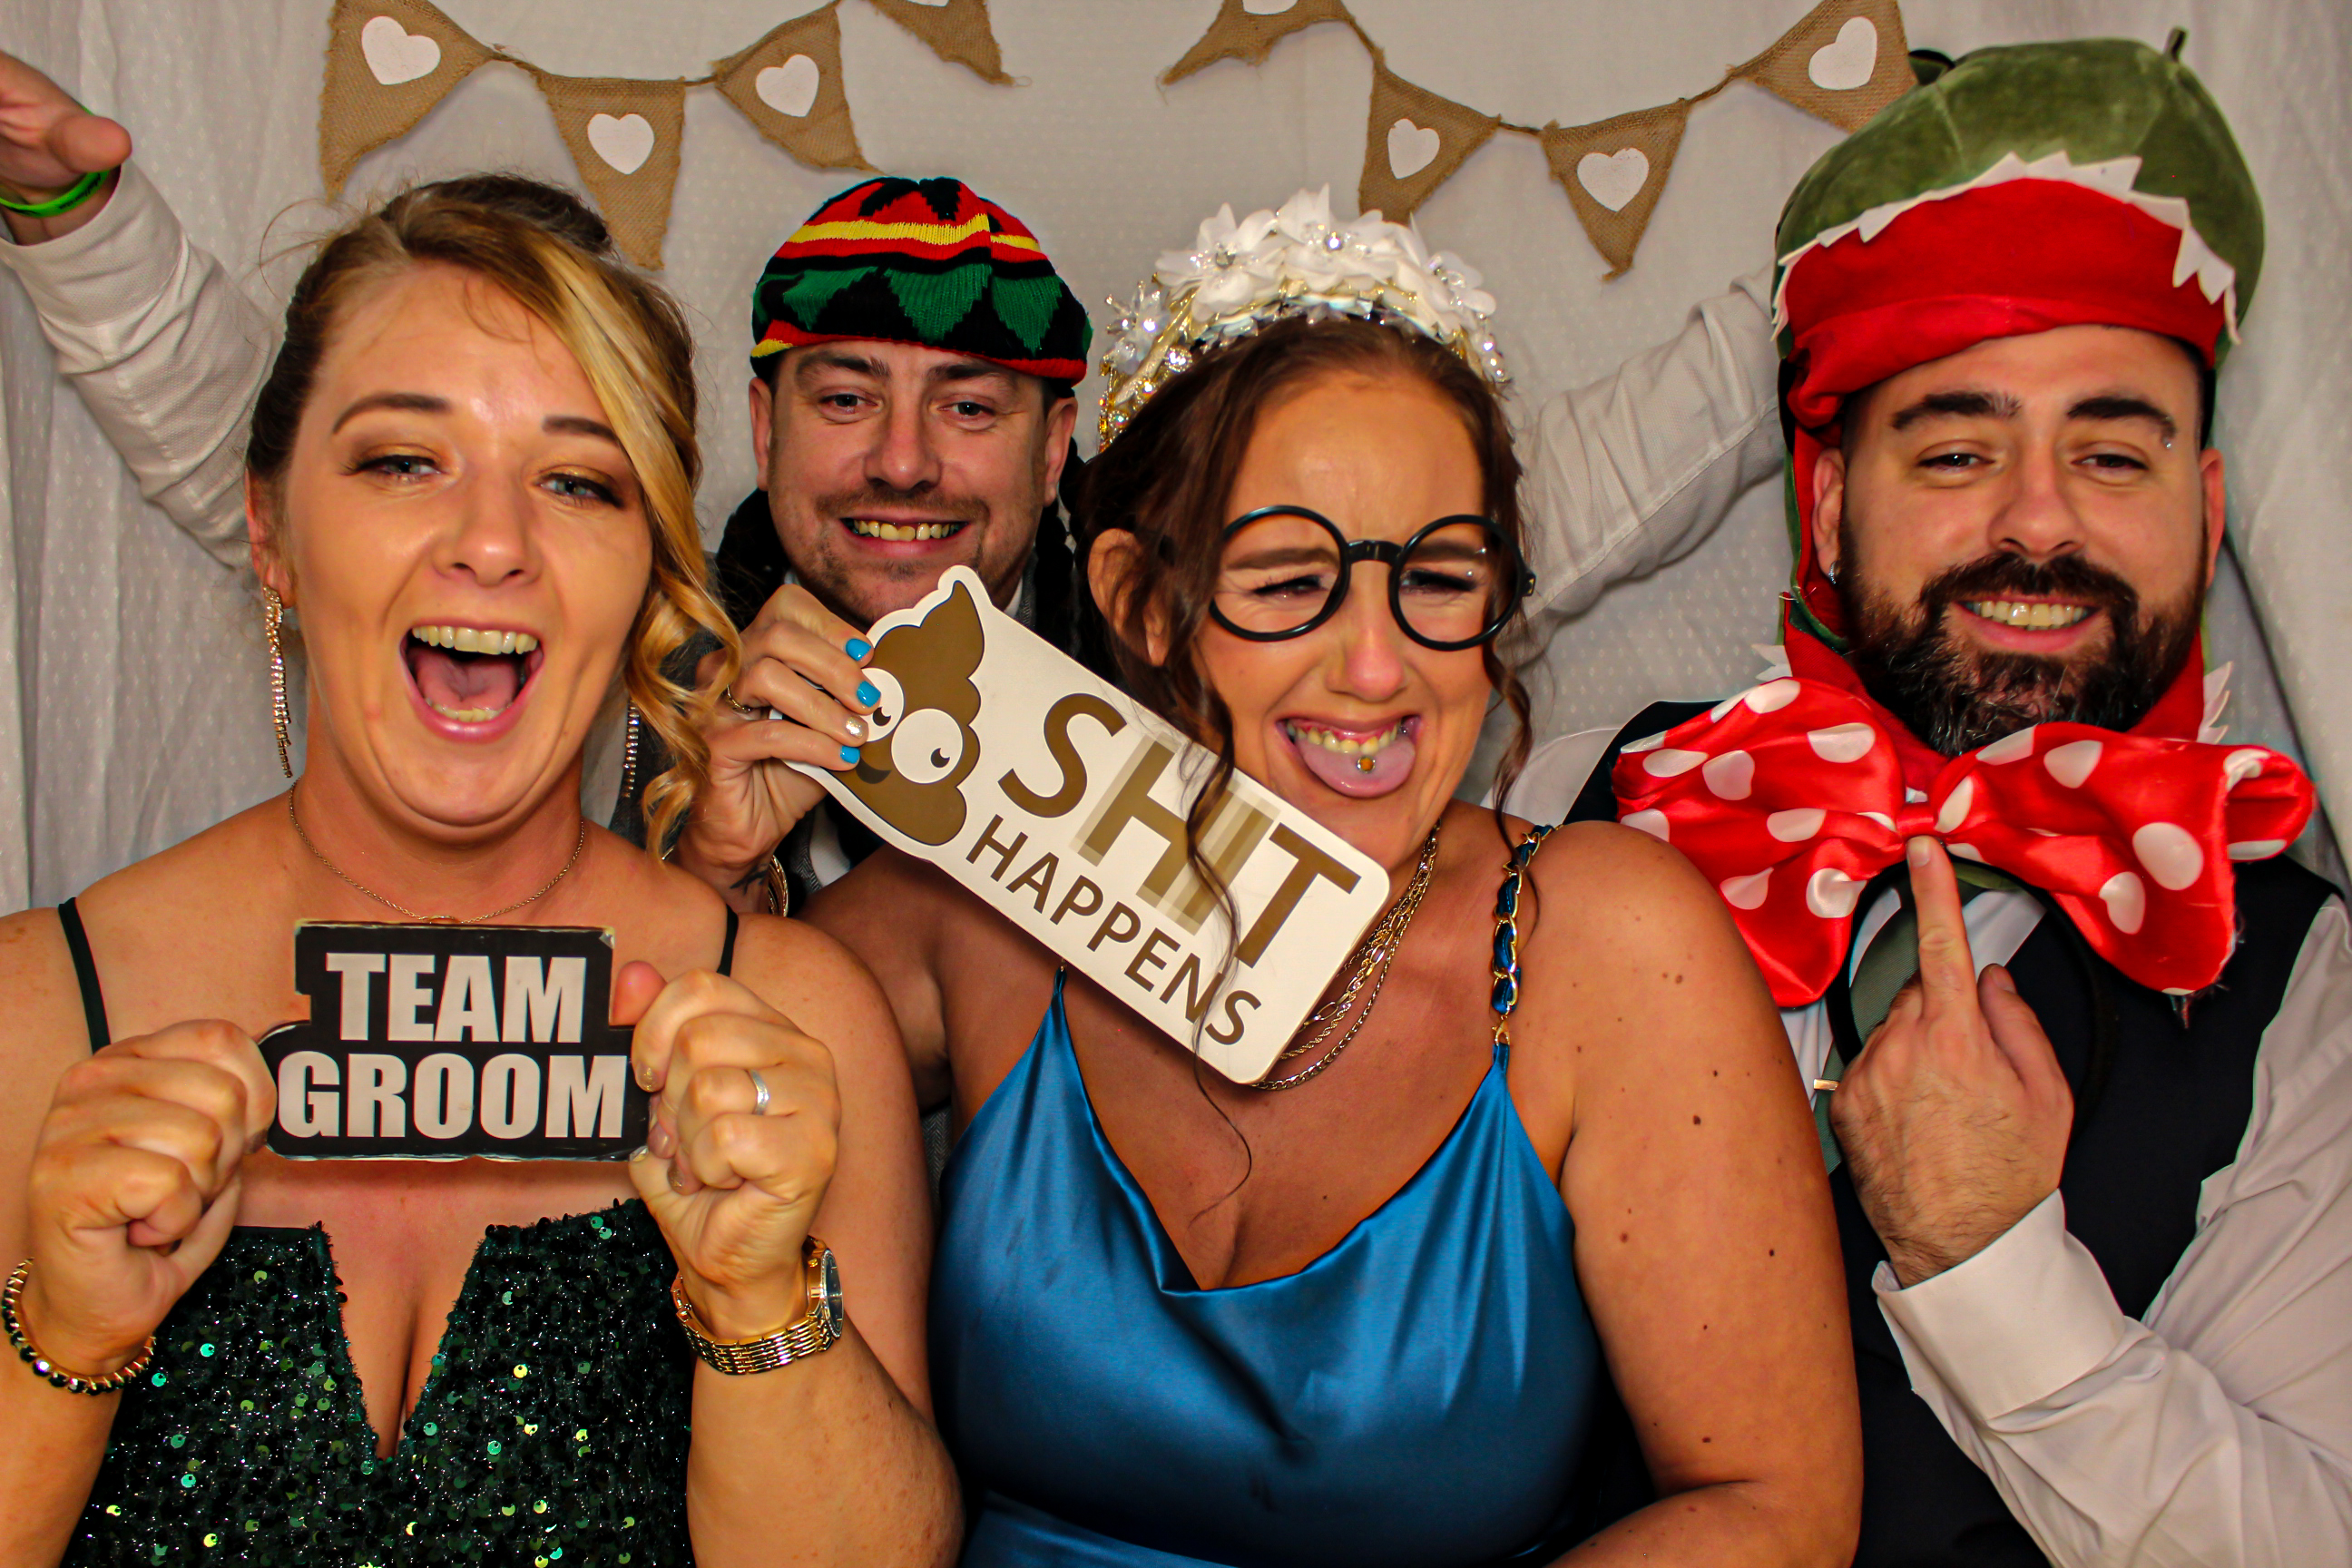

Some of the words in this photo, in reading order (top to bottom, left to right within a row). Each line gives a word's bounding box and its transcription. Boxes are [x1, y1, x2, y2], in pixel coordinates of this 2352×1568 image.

[997, 692, 1361, 968] SHIT
[325, 952, 587, 1043] TEAM
[965, 815, 1262, 1045] HAPPENS
[278, 1051, 628, 1139] GROOM
